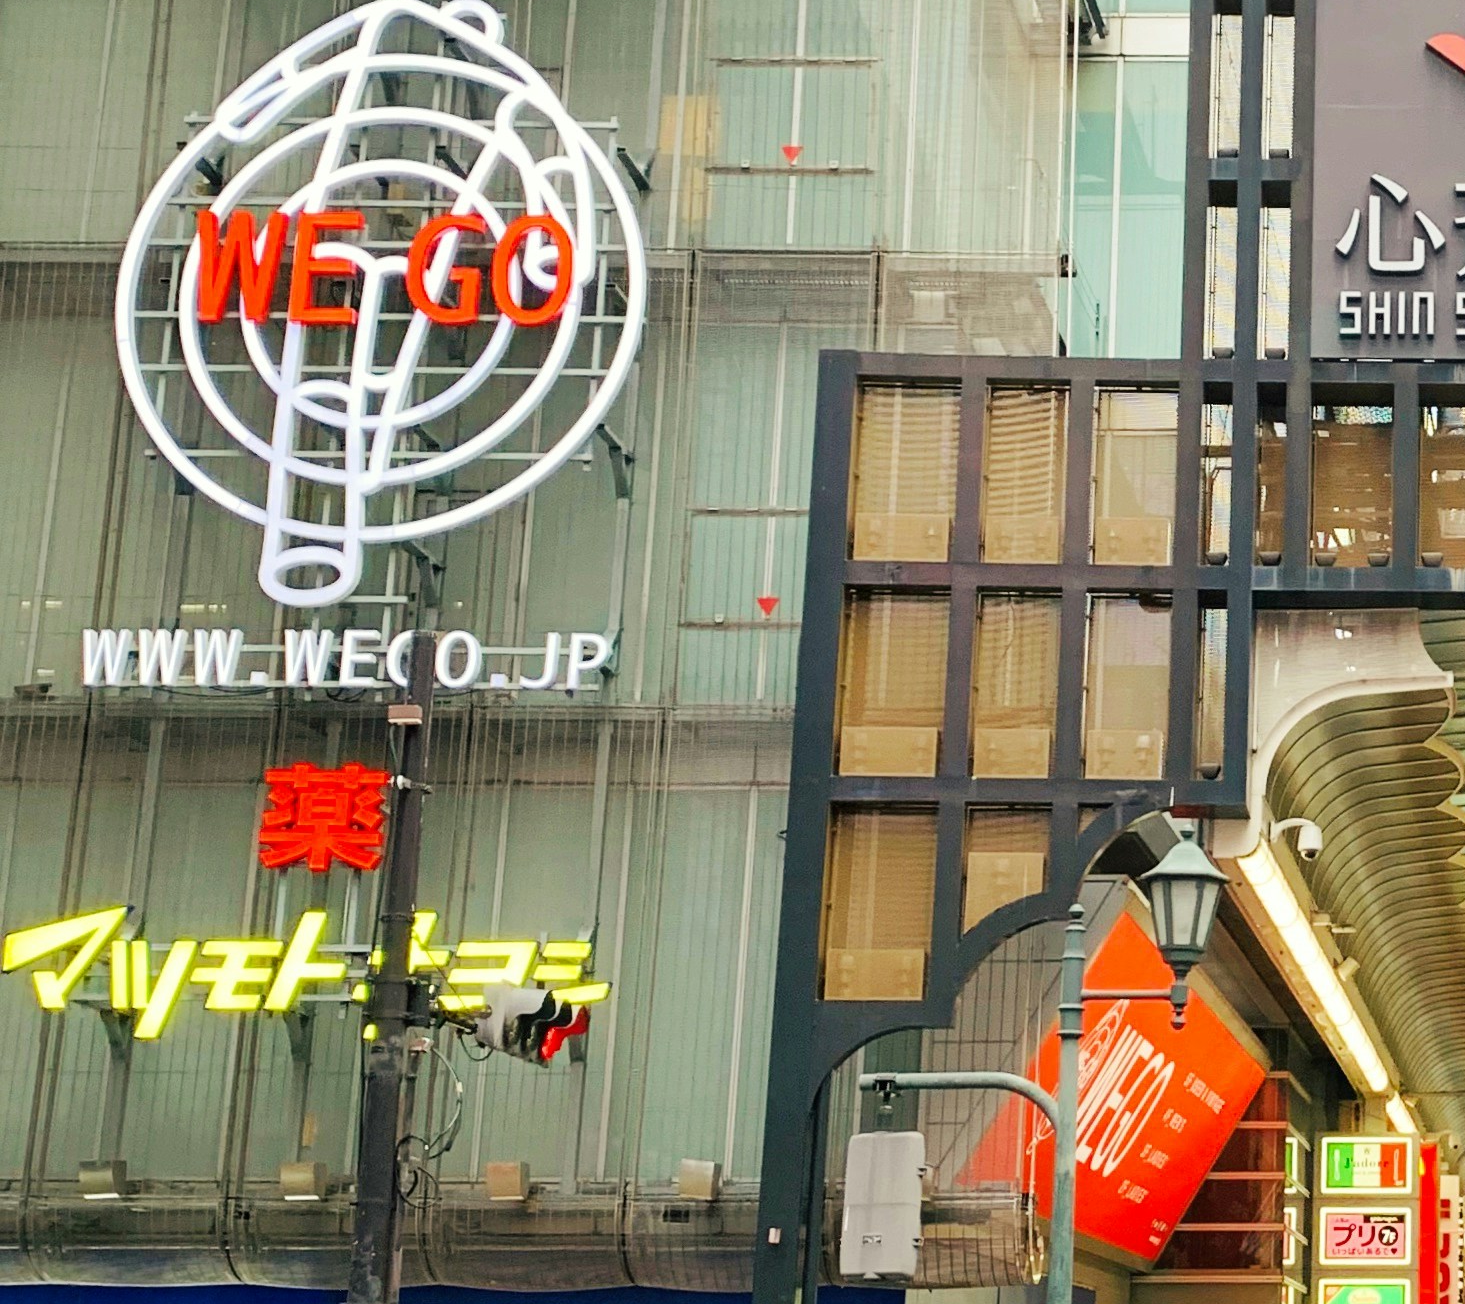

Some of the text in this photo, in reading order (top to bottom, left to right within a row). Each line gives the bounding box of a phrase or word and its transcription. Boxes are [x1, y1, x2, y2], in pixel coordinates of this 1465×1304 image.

[196, 209, 575, 328] WE GO
[1338, 291, 1435, 338] SHIN
[259, 762, 390, 872] 薬
[1332, 1223, 1377, 1248] プリ
[1380, 1227, 1398, 1245] 7F
